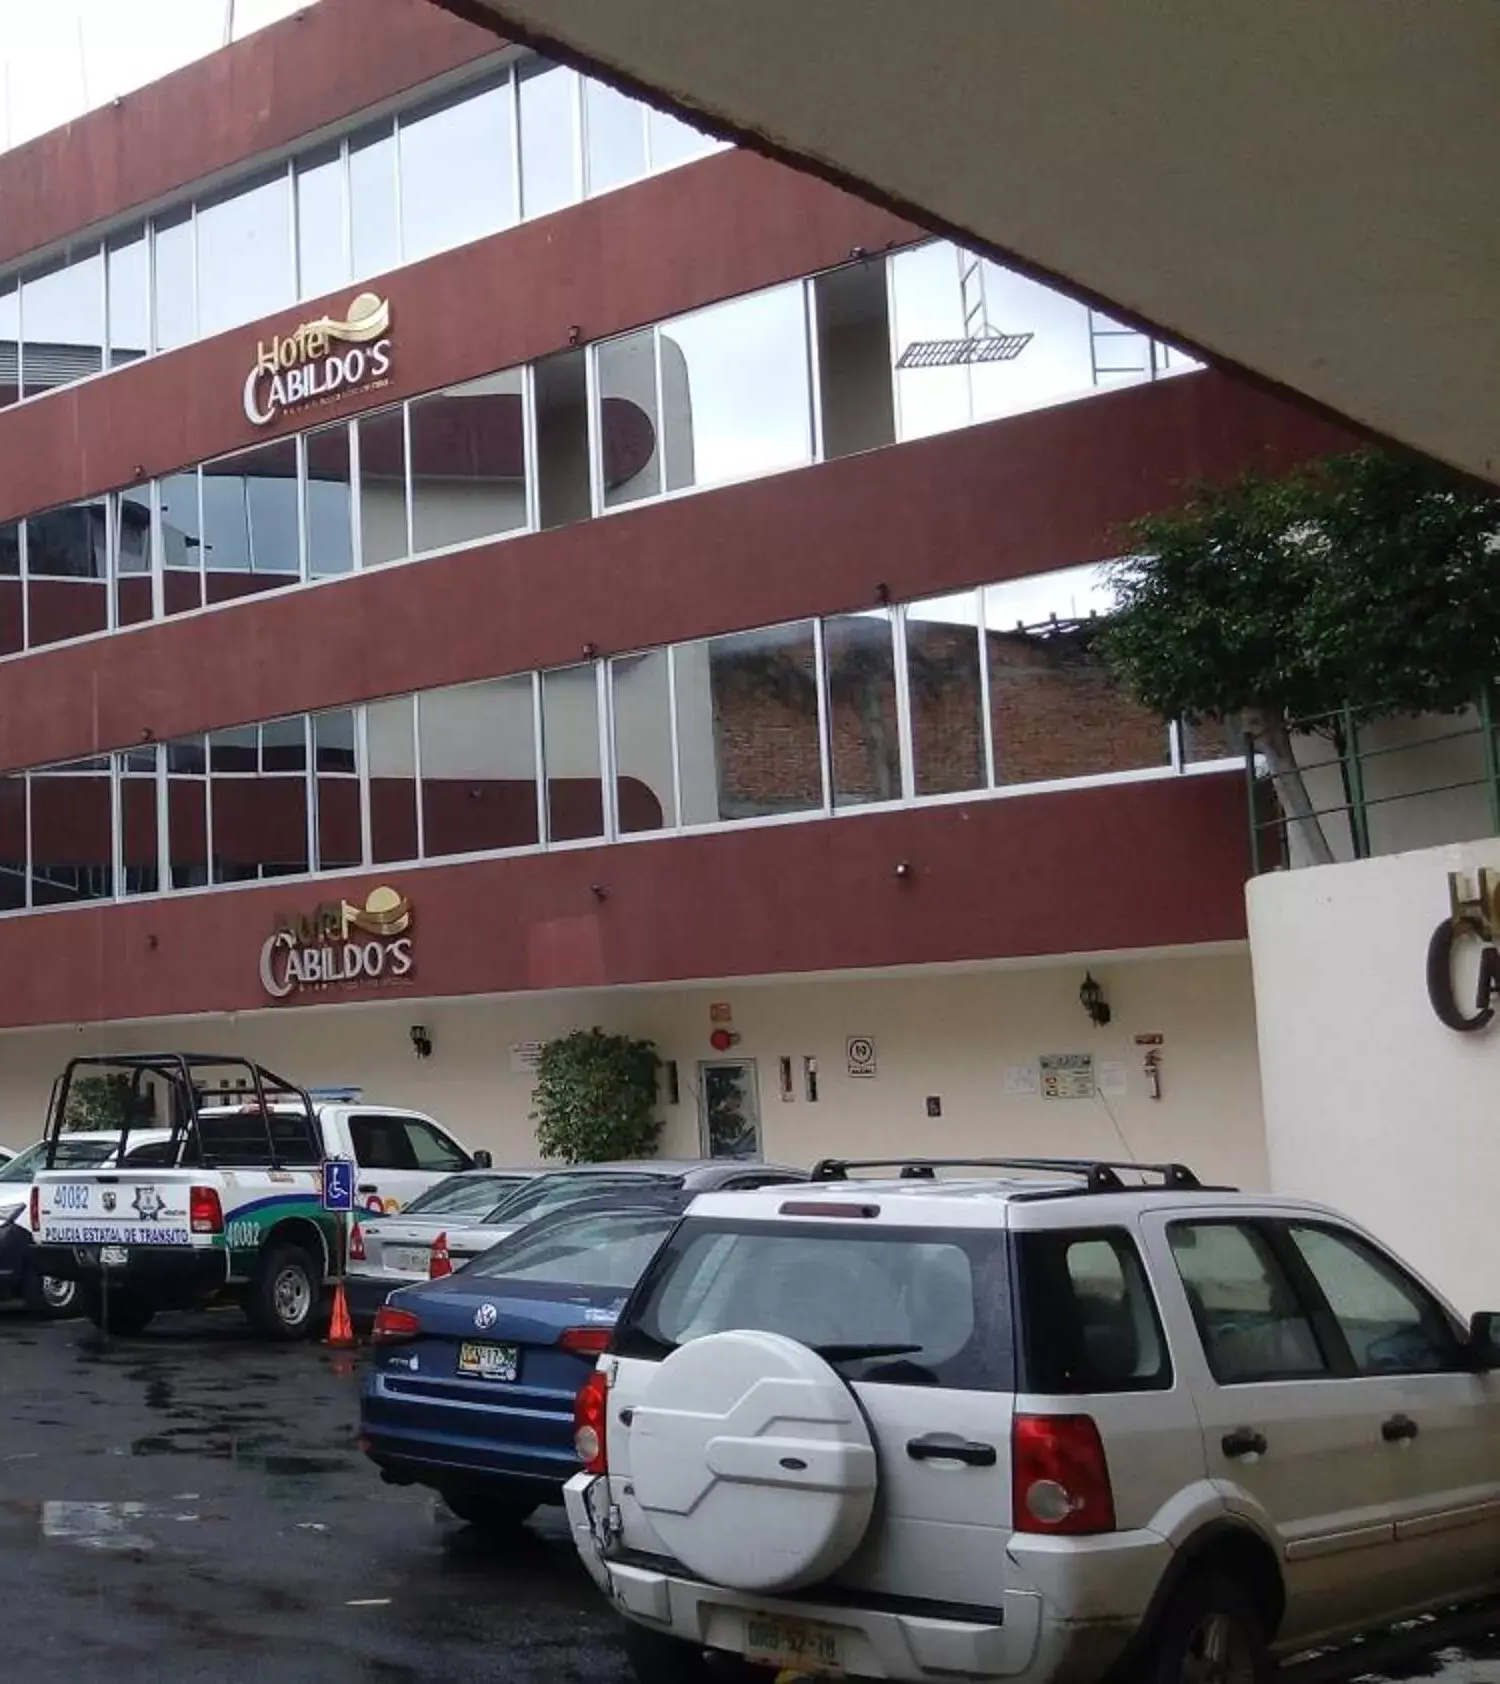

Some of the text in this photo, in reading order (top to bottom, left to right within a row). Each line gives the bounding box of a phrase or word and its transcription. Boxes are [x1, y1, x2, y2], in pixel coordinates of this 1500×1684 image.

[45, 1227, 80, 1242] POLICIA
[83, 1228, 121, 1242] ESTATAL
[124, 1229, 137, 1242] DE
